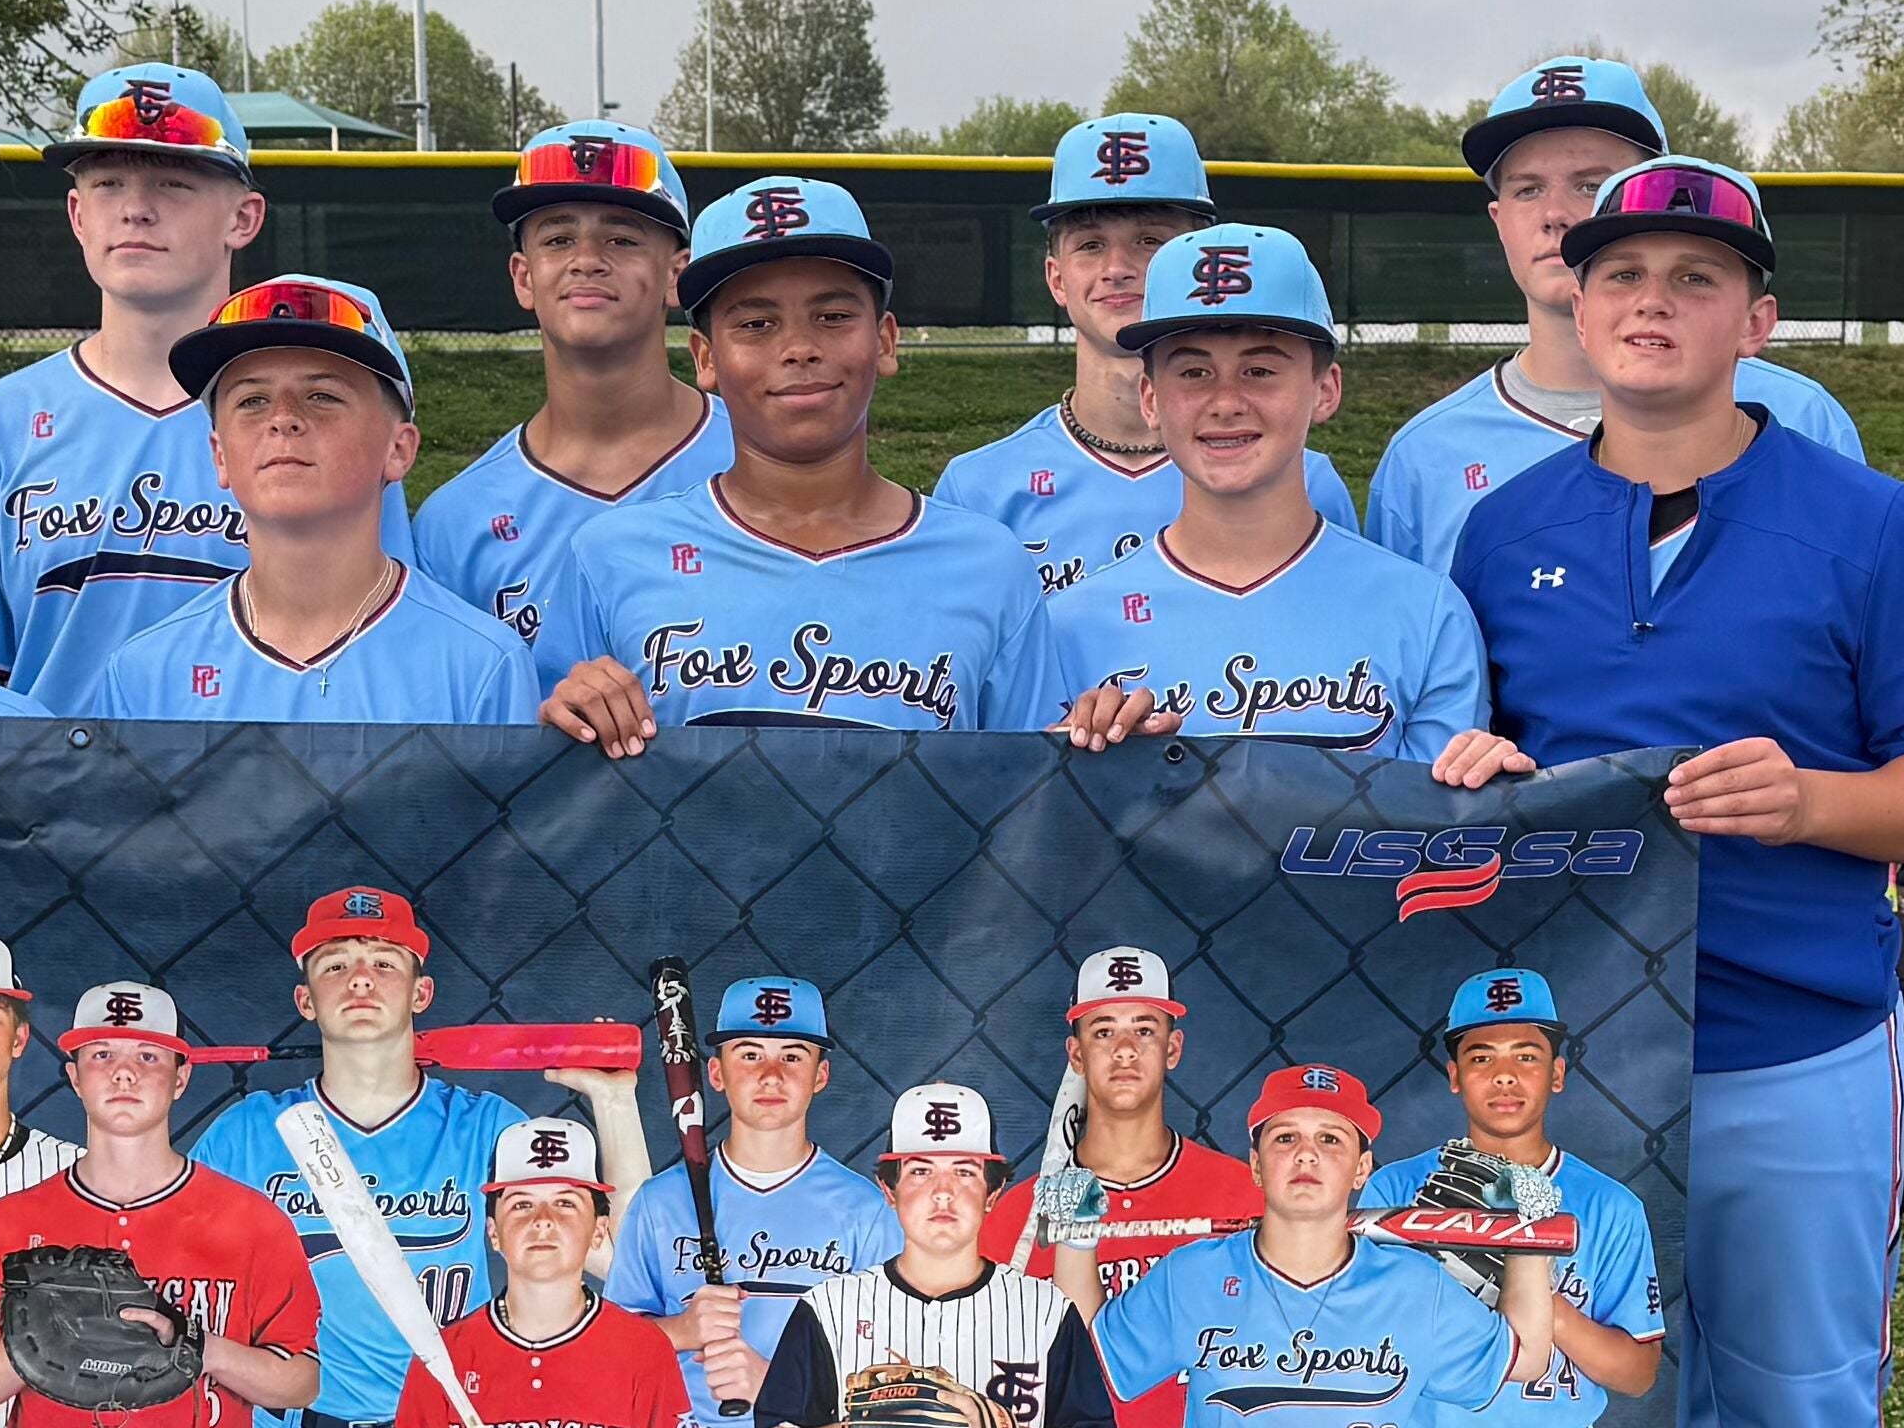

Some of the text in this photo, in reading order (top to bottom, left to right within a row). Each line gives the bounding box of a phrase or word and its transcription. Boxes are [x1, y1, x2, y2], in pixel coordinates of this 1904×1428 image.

[3, 470, 251, 556] Fox Spor
[642, 617, 959, 729] Fox Sports
[1205, 652, 1394, 733] Sports
[737, 1229, 851, 1277] Sports
[1194, 1325, 1408, 1384] Fox Sports
